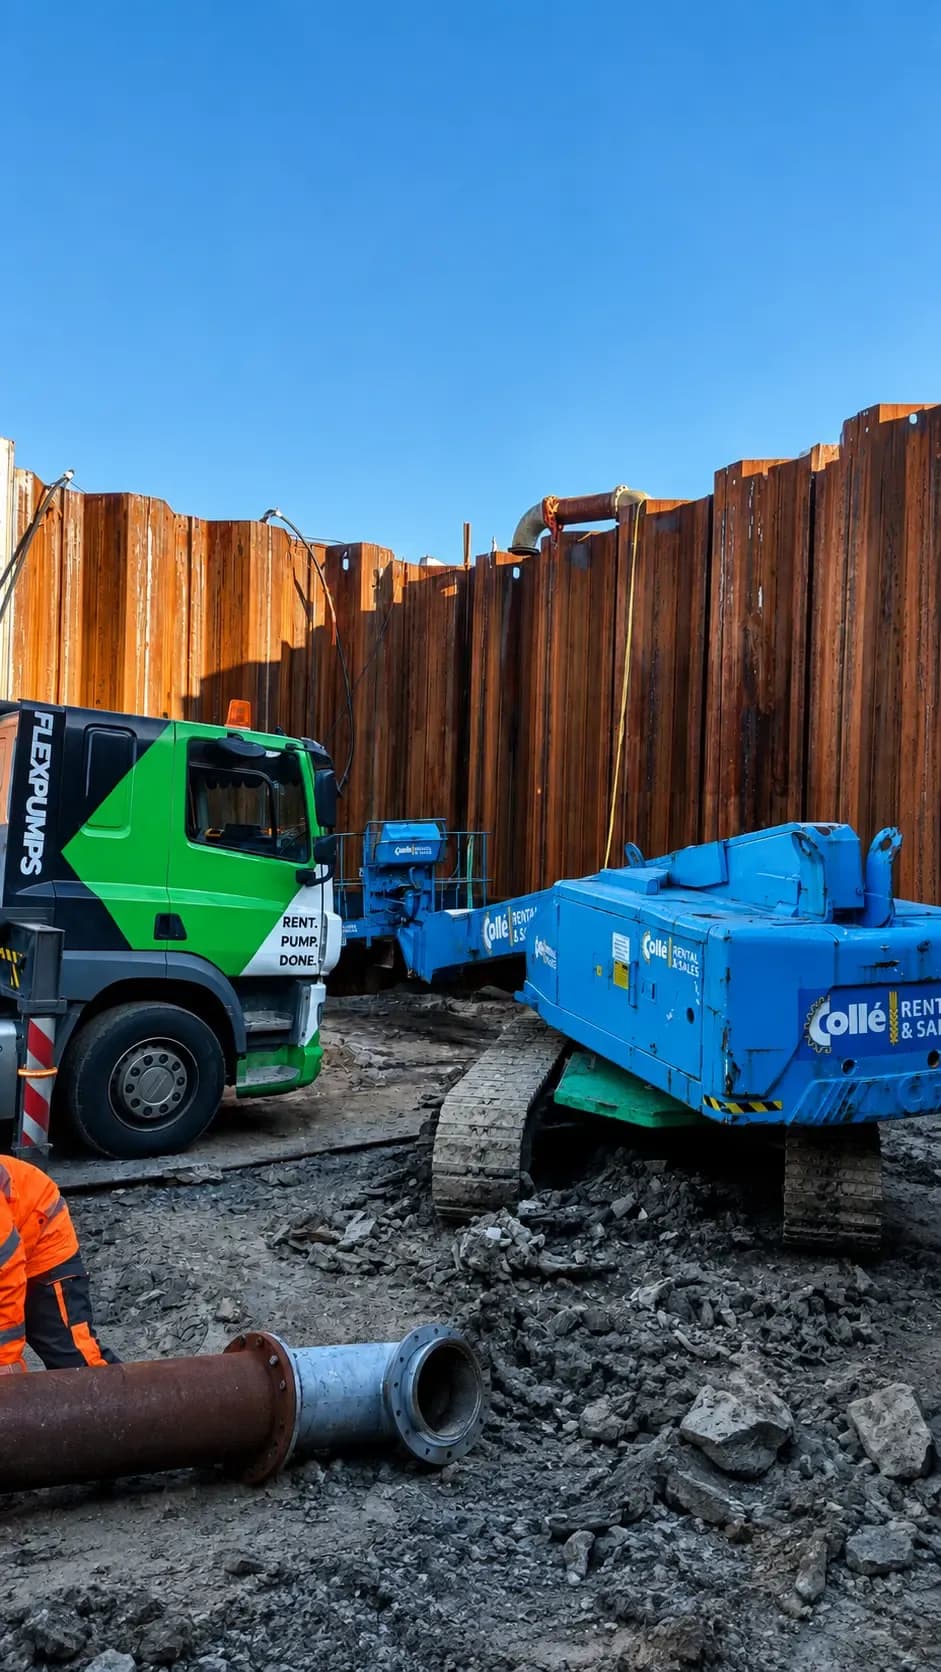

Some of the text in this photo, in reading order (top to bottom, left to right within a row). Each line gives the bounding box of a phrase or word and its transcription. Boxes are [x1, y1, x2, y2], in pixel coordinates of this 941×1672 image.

[20, 711, 54, 876] FLEXPUMPS
[282, 916, 318, 928] RENT.
[484, 914, 509, 950] Collé
[280, 935, 318, 948] PUMP.
[642, 934, 668, 960] Collé
[279, 954, 317, 966] DONE.
[808, 1001, 887, 1047] Collé
[901, 1022, 913, 1039] &
